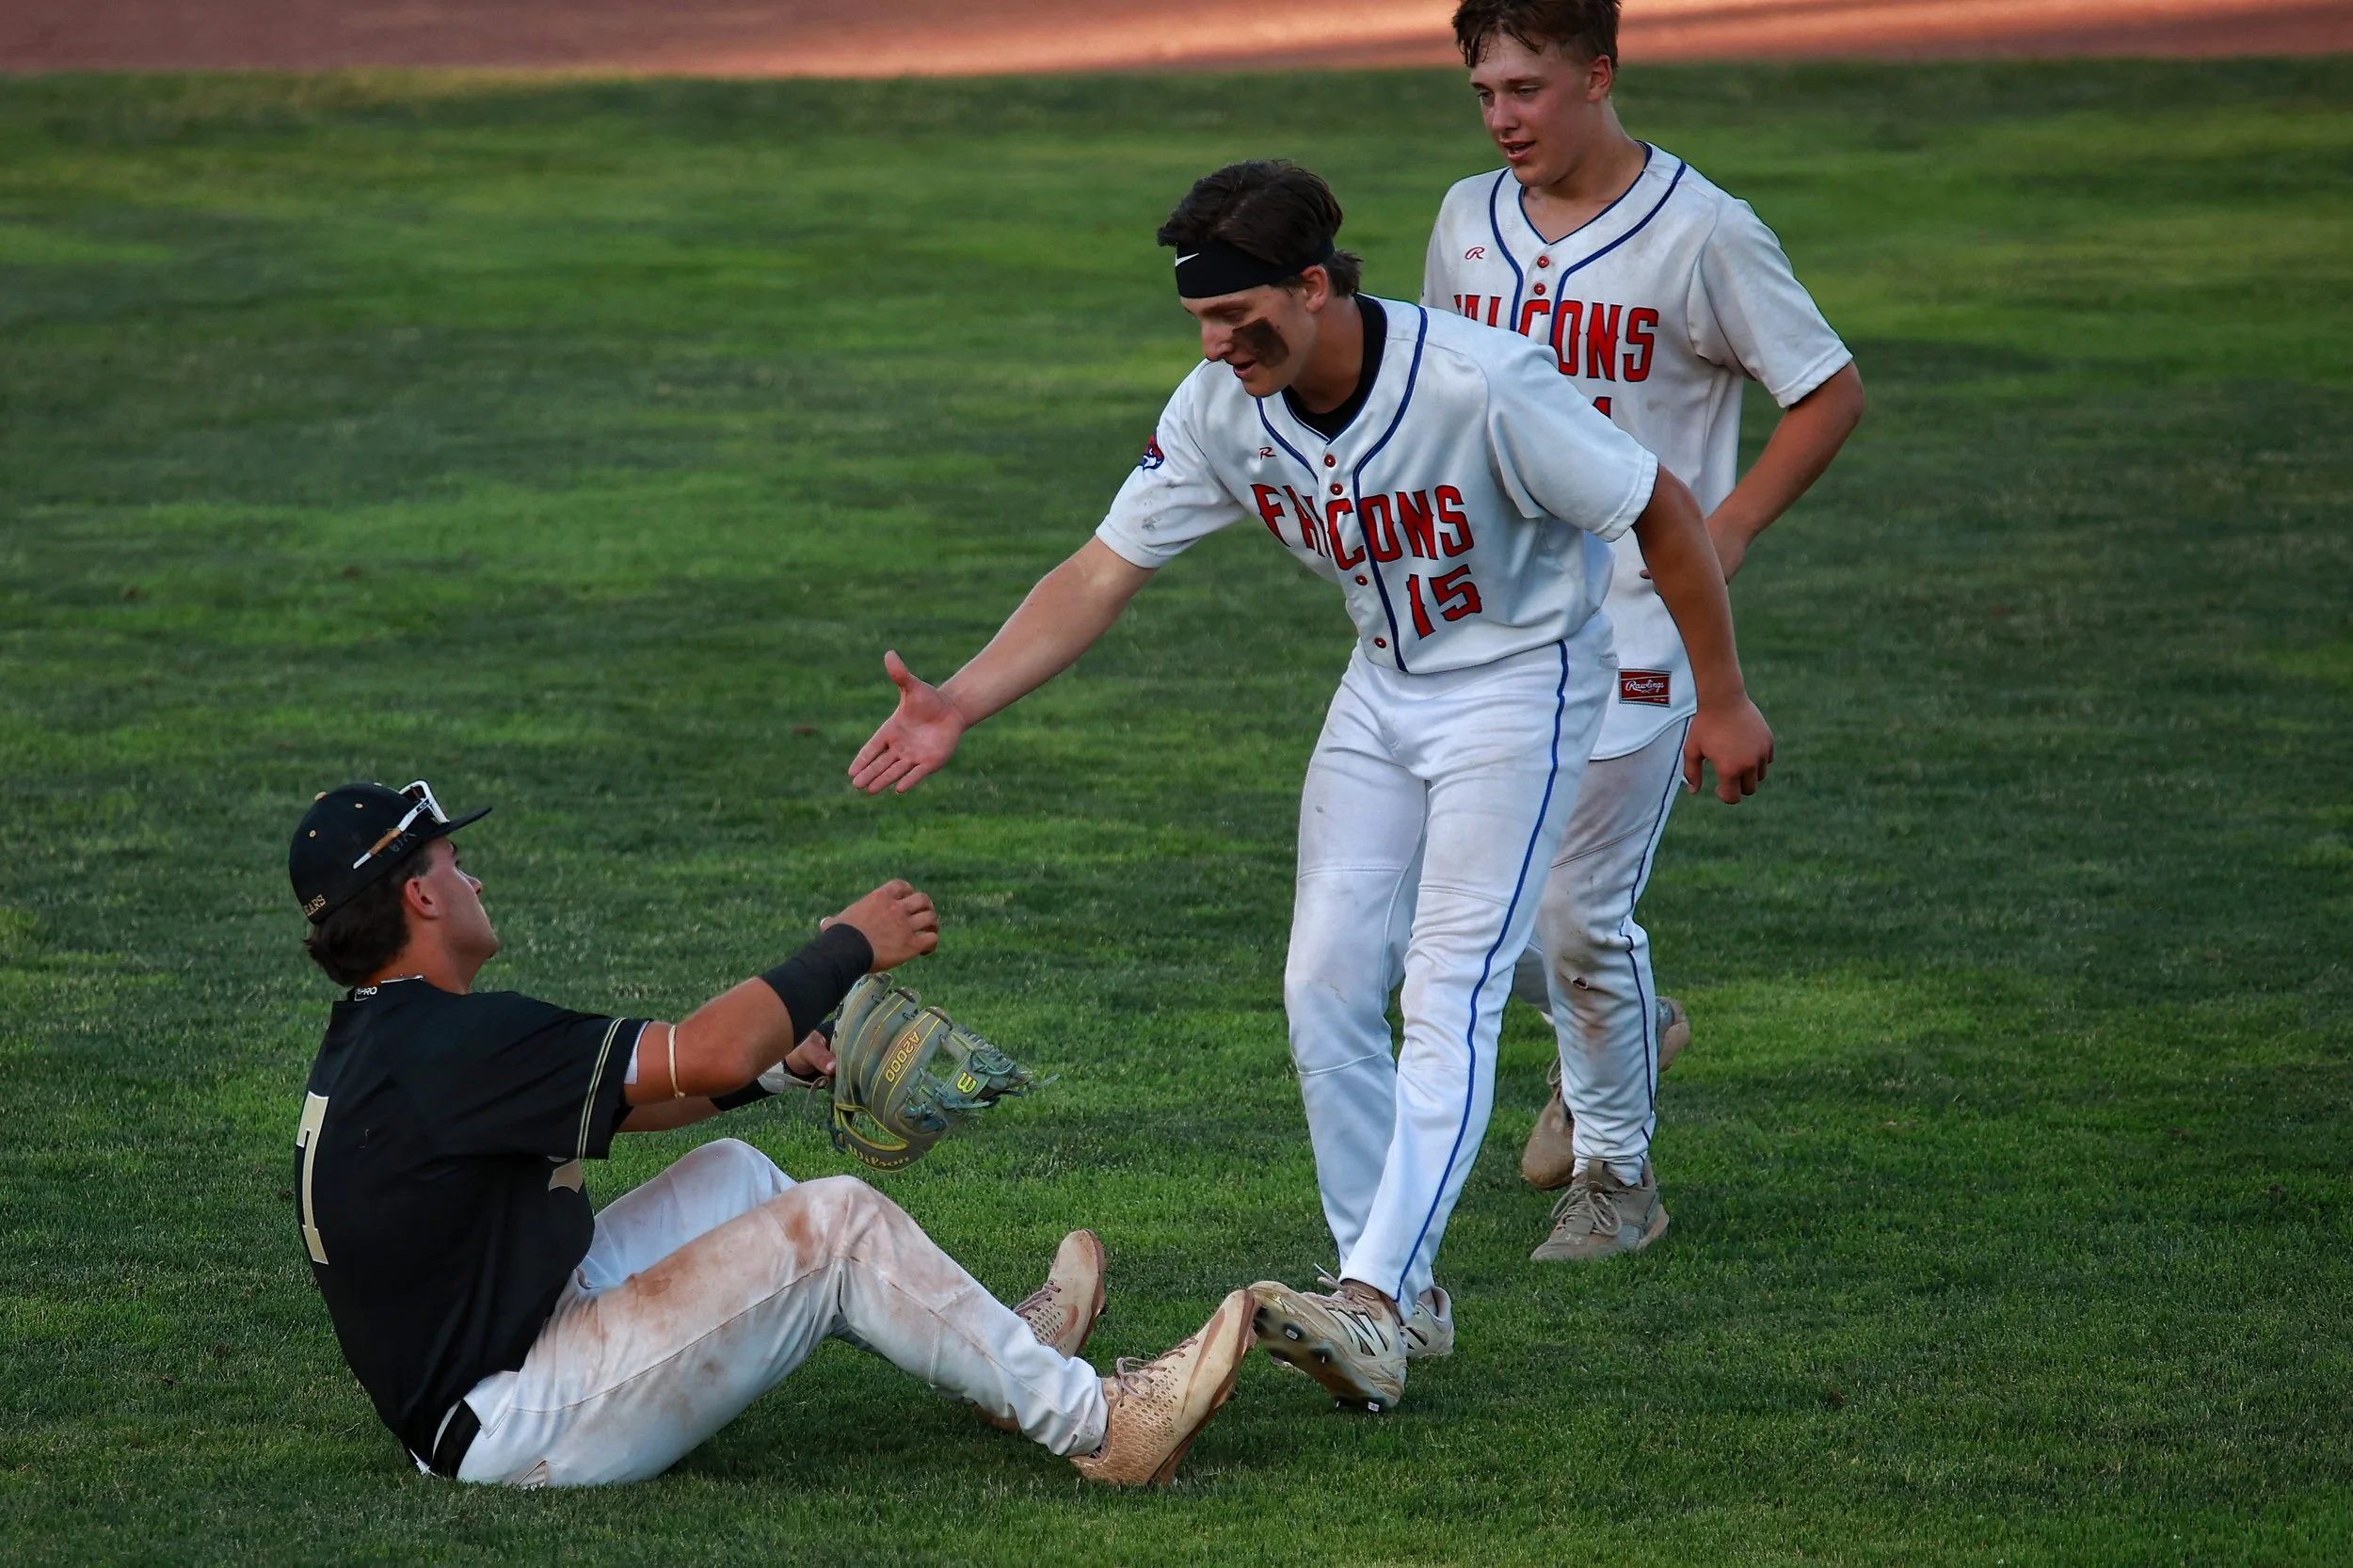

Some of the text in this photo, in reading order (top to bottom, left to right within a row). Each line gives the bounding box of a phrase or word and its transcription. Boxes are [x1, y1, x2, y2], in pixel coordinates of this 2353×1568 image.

[1250, 484, 1475, 571] FACONS
[1405, 563, 1483, 640] 15
[885, 1031, 921, 1083] A2000
